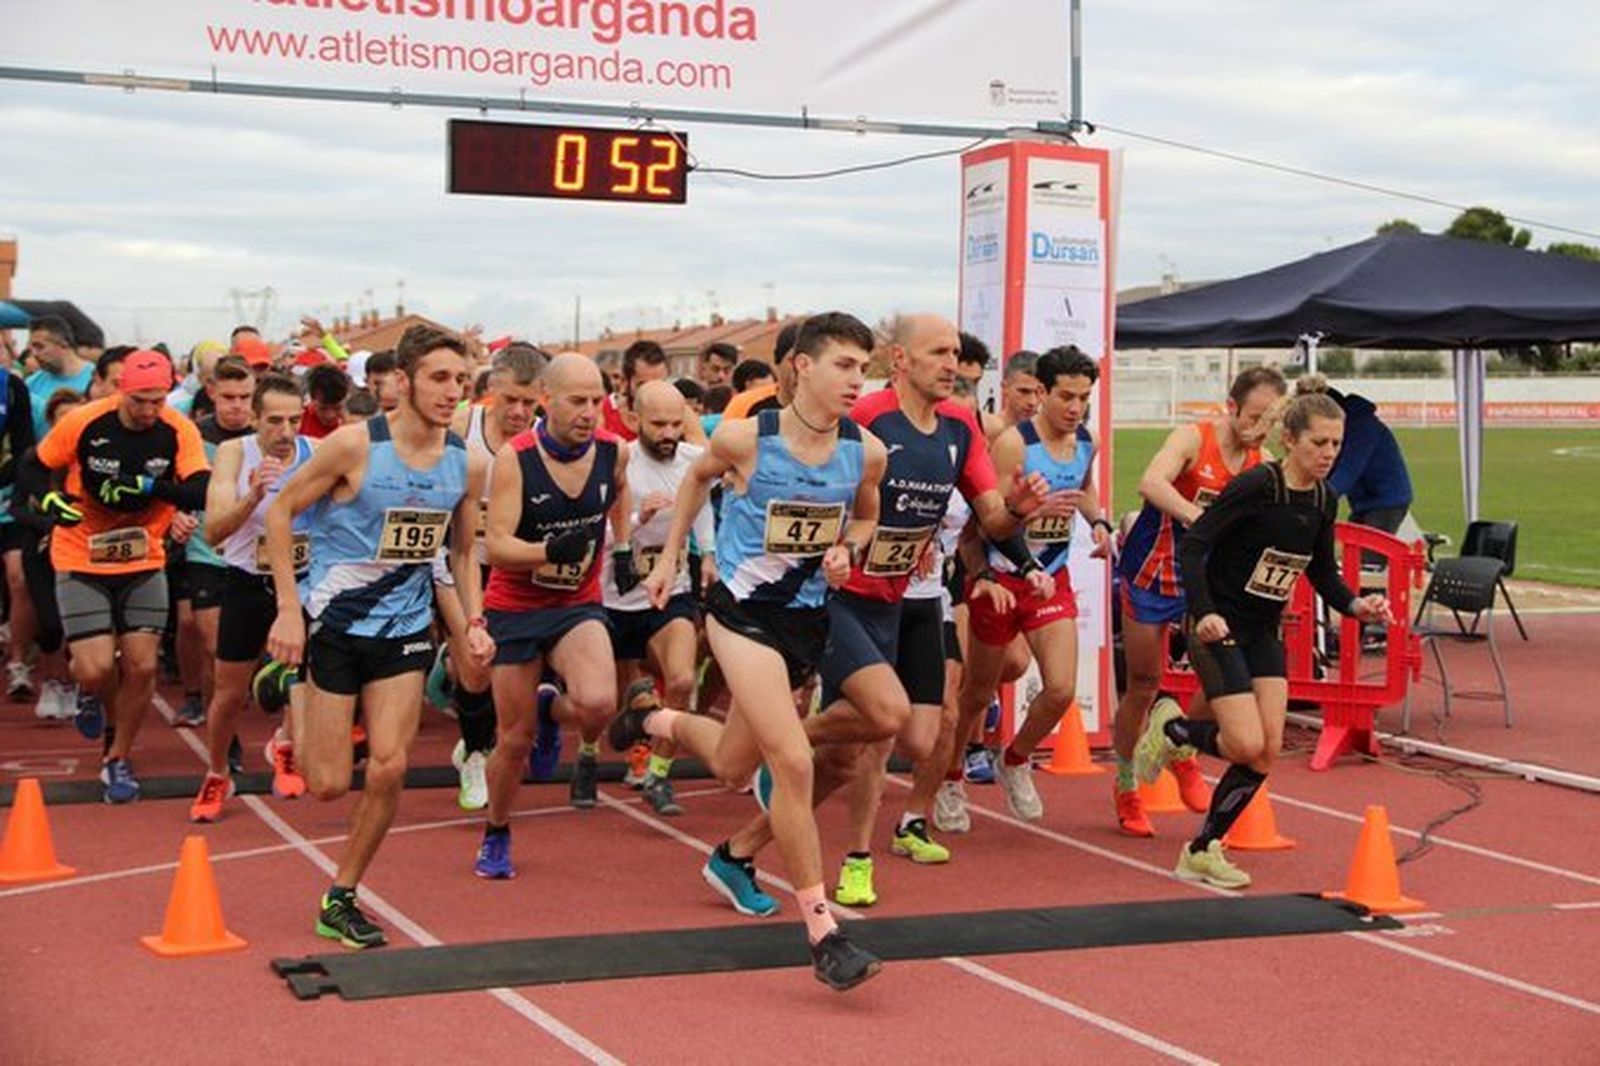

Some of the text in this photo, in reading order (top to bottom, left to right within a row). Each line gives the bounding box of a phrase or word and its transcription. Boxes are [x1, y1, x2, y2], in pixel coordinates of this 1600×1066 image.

[207, 24, 732, 90] www.atletismoarganda.com
[554, 134, 678, 196] 0 52
[1032, 232, 1099, 262] Dursan
[393, 526, 436, 548] 195
[787, 520, 822, 542] 47
[106, 543, 132, 558] 28
[886, 543, 916, 563] 24
